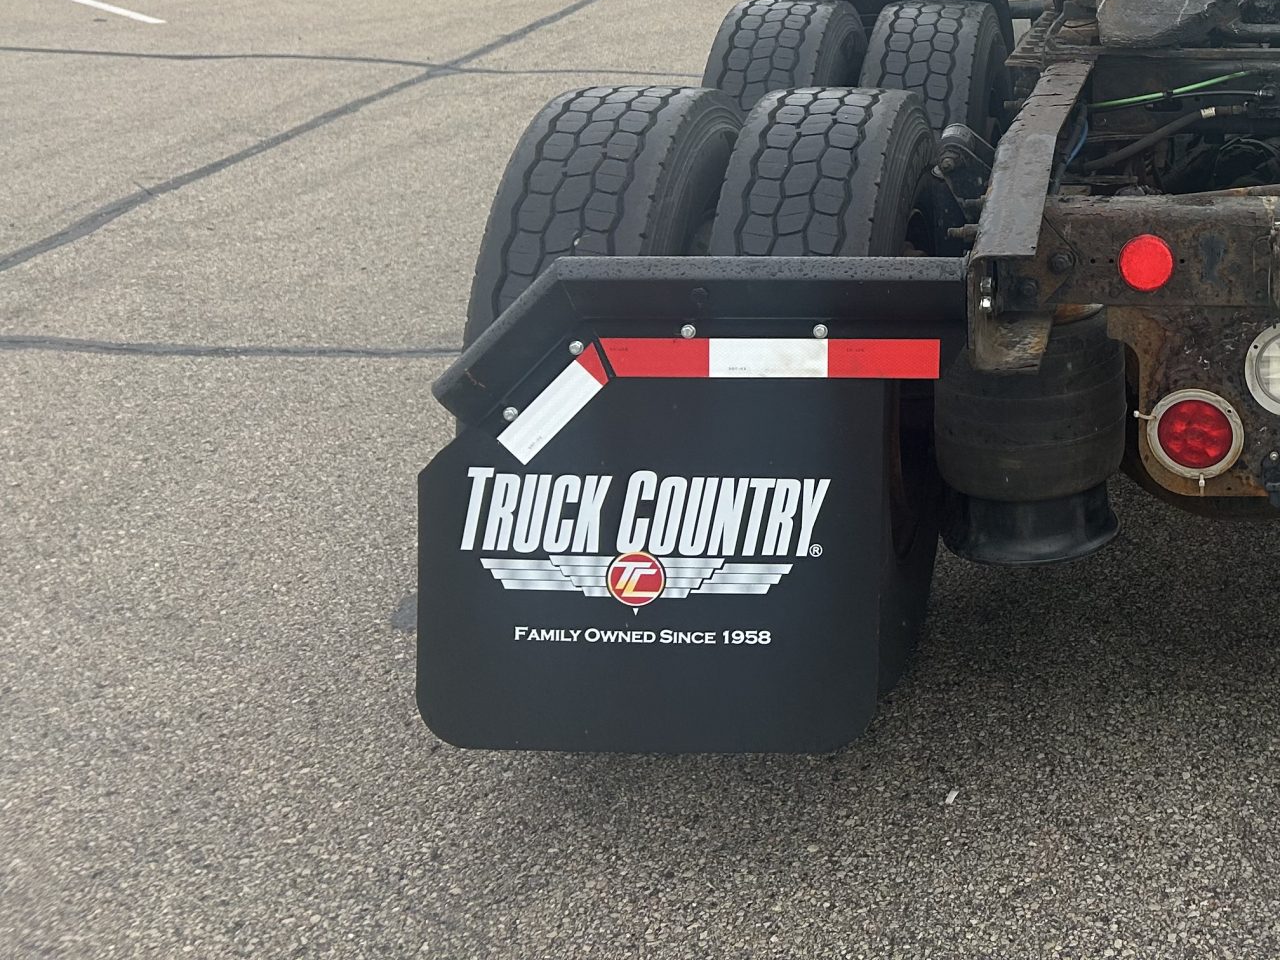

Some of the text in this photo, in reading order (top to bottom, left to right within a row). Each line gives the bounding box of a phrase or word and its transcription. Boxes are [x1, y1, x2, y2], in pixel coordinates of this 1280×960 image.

[460, 467, 612, 553] TRUCK
[514, 625, 772, 645] FAMILY OWNED SINCE 1958
